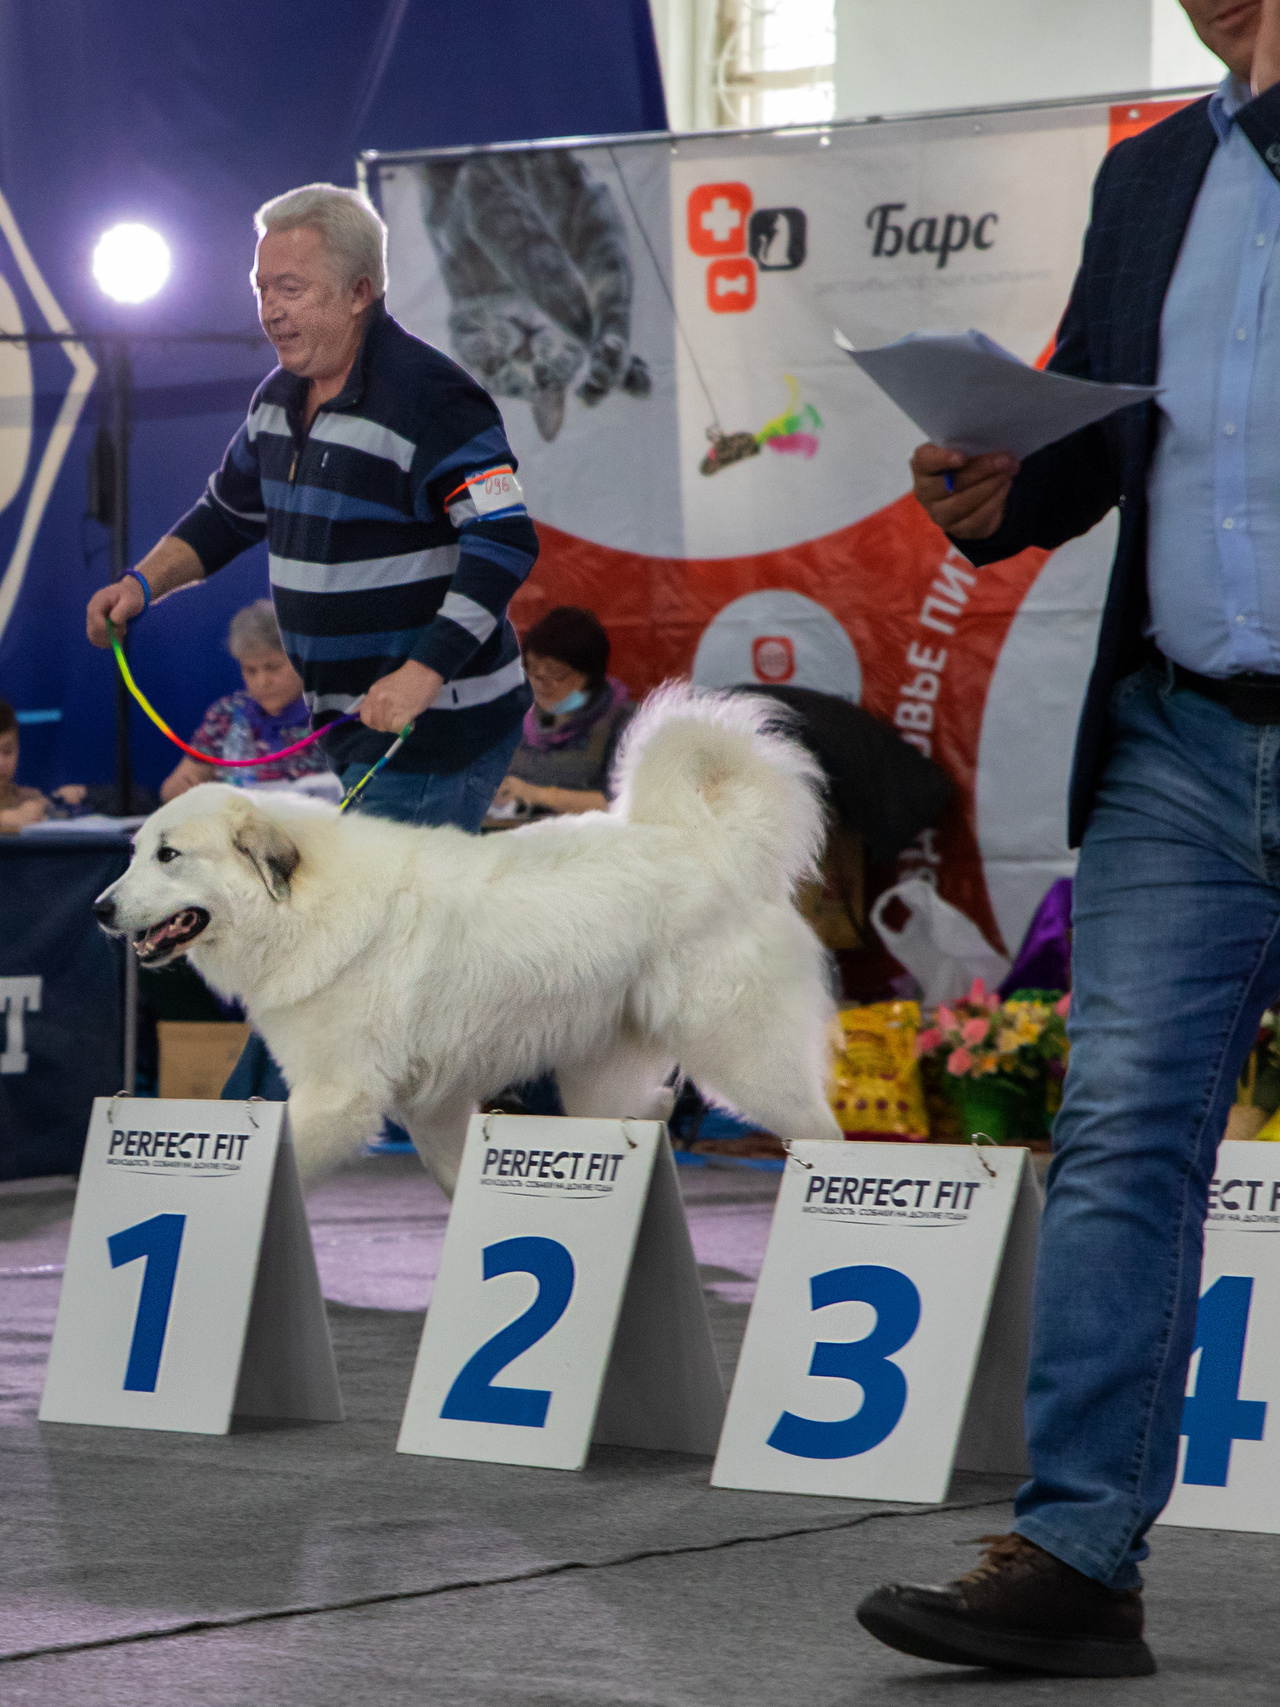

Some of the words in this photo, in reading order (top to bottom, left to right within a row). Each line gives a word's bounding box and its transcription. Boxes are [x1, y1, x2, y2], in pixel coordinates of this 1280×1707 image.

[866, 202, 999, 270] Барс
[108, 1129, 211, 1160] PERFECT
[212, 1133, 251, 1161] FIT
[482, 1148, 585, 1181] PERFECT
[585, 1153, 626, 1182] FIT
[804, 1175, 932, 1209] PERFECT
[933, 1180, 982, 1210] FIT
[106, 1213, 187, 1393] 1
[439, 1235, 576, 1429] 2
[766, 1265, 921, 1460] 3
[1180, 1275, 1268, 1487] 4
